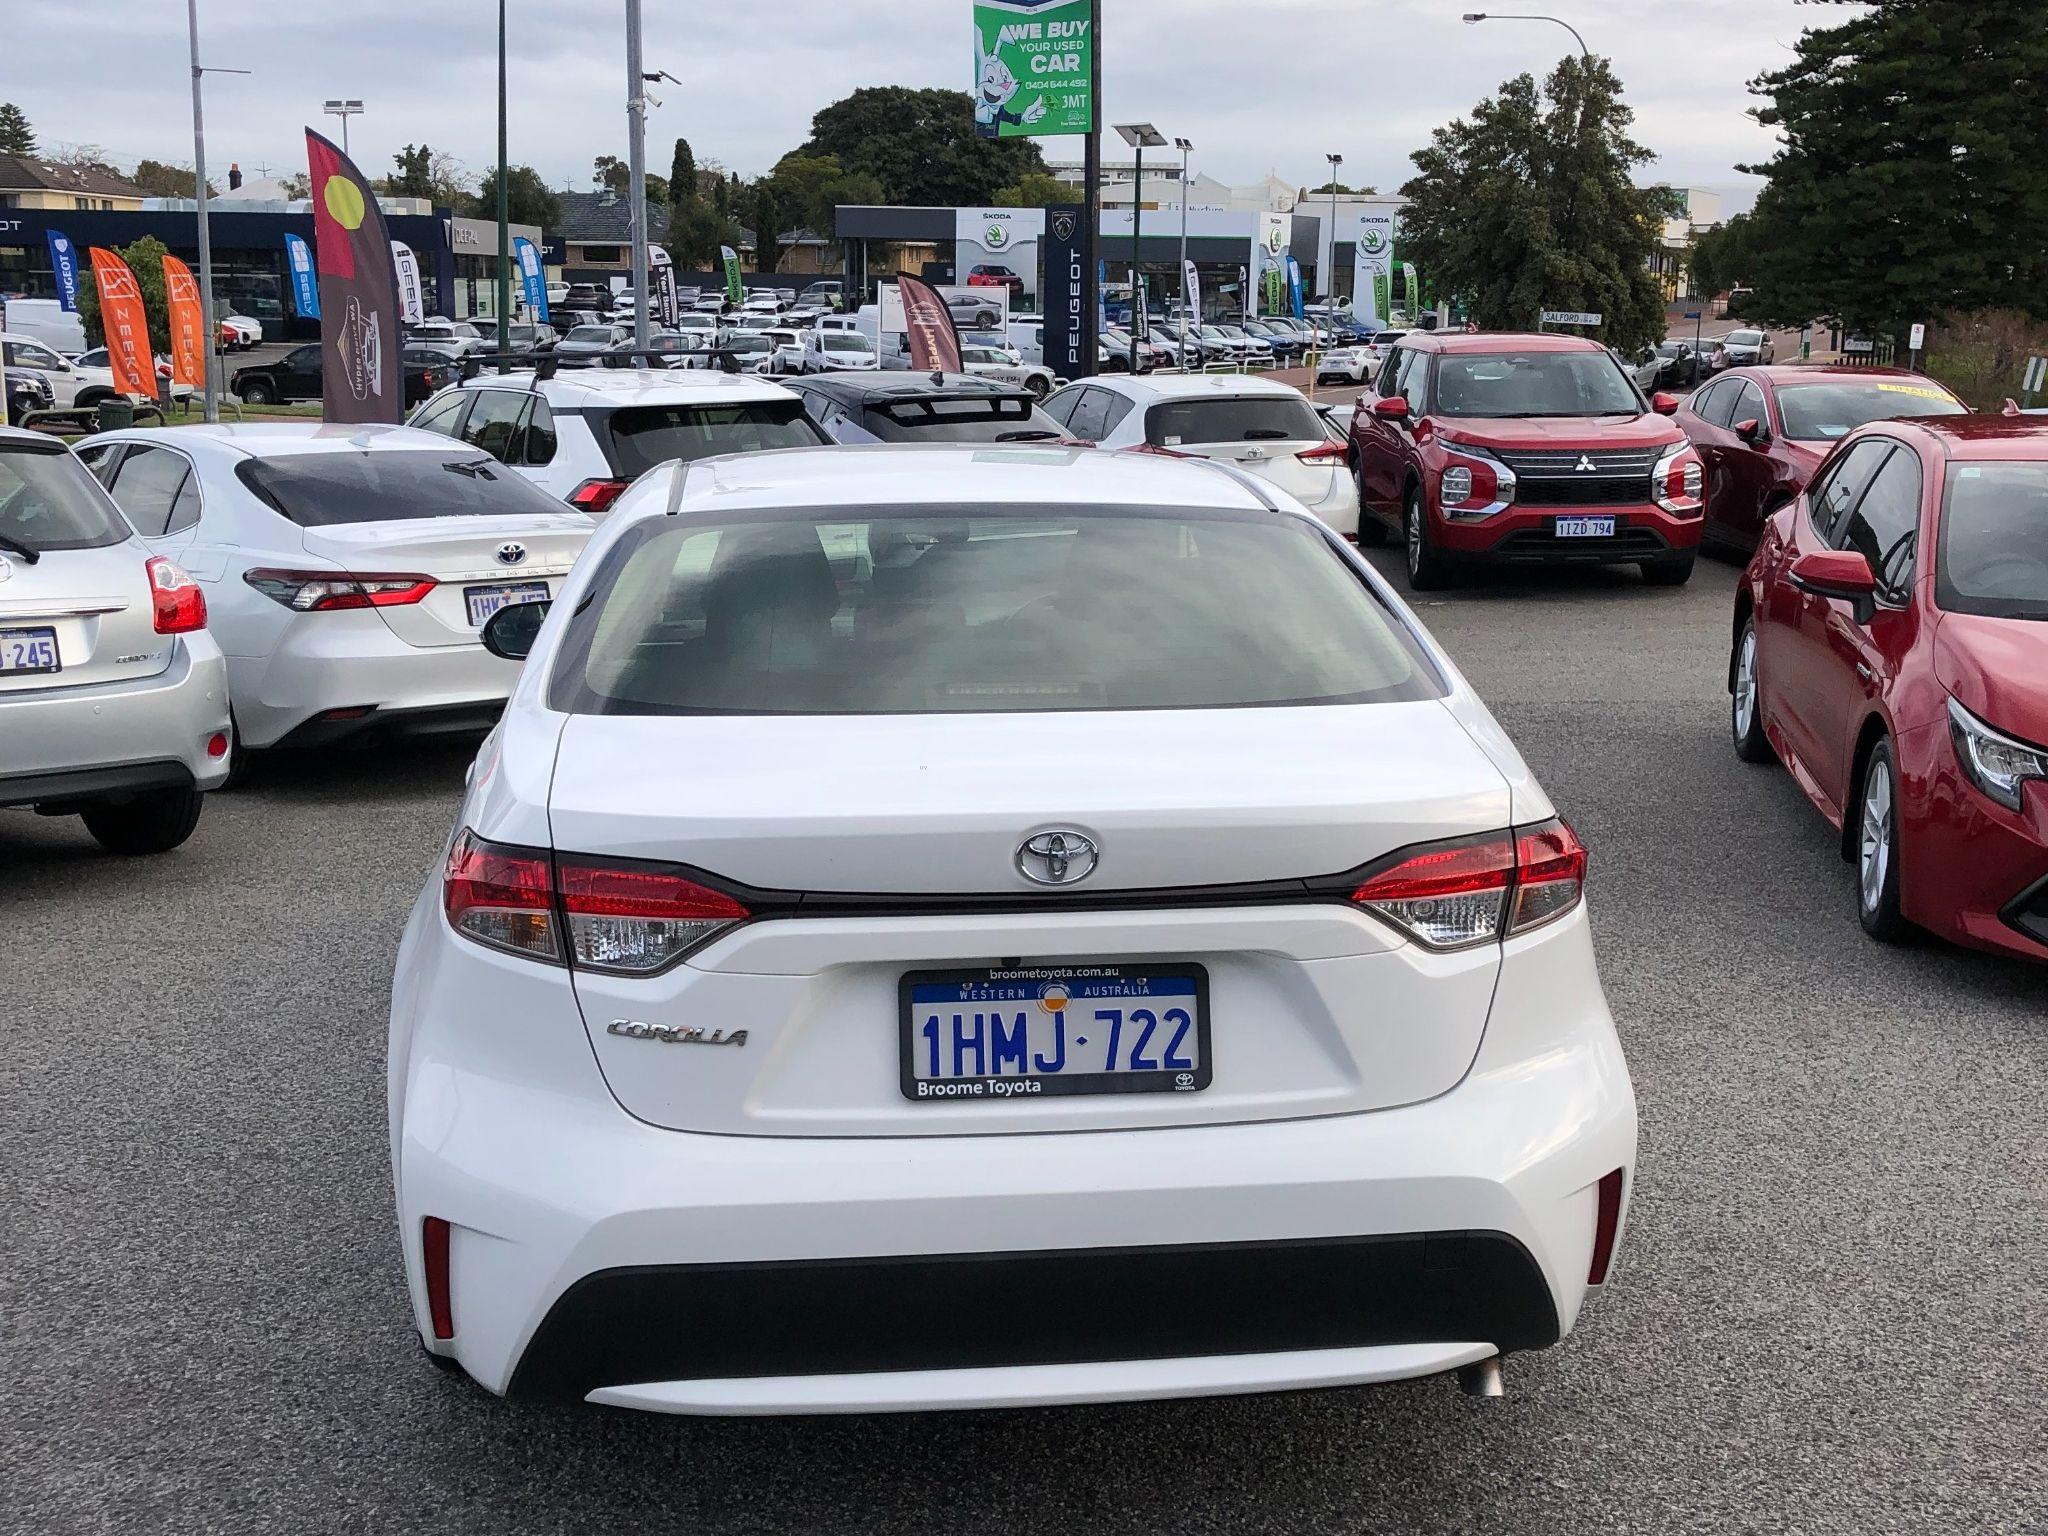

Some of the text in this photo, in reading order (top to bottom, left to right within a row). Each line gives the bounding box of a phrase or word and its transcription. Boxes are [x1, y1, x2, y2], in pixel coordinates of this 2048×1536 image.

[1047, 20, 1090, 38] BUY
[1020, 40, 1084, 53] YOUR USED
[1030, 53, 1080, 73] CAR
[1069, 79, 1087, 88] 492
[59, 254, 77, 310] PEUGEOT
[400, 260, 420, 321] GEELY
[300, 273, 313, 316] GEELY
[1068, 248, 1081, 364] PEUGEOT
[1545, 312, 1580, 323] SALFORD
[116, 307, 140, 386] ZEEKR
[181, 310, 195, 378] ZEEKR
[354, 357, 364, 392] HYPER
[989, 966, 1120, 980] broometoyota.com.au
[959, 985, 1151, 1001] WESTERN AUSTRALIA
[606, 1018, 750, 1047] COROLLA
[917, 1078, 1042, 1097] Broome Toyota
